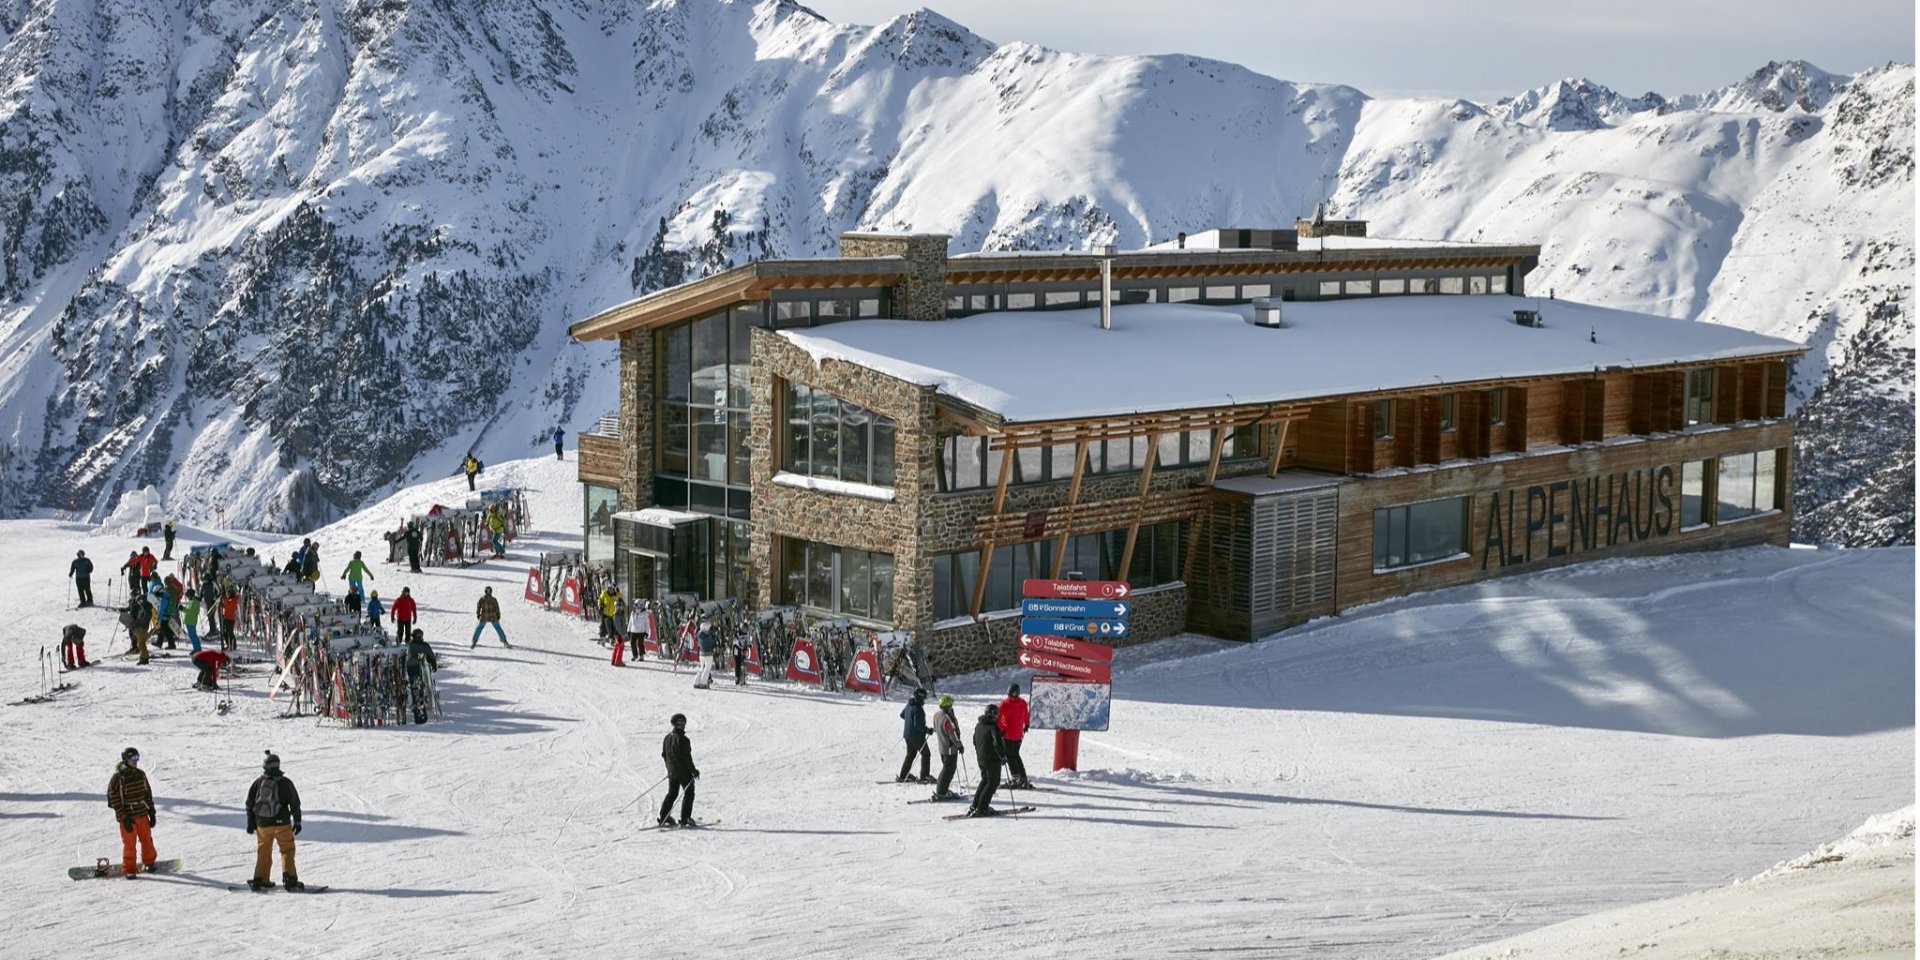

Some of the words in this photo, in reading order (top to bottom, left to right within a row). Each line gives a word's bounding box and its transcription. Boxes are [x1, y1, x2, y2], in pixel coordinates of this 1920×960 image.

[1481, 465, 1673, 570] ALPENHAUS
[1052, 583, 1087, 591] Talabfahrt
[1043, 604, 1086, 612] Sonnenbahn
[1044, 638, 1075, 649] Talabfahrt
